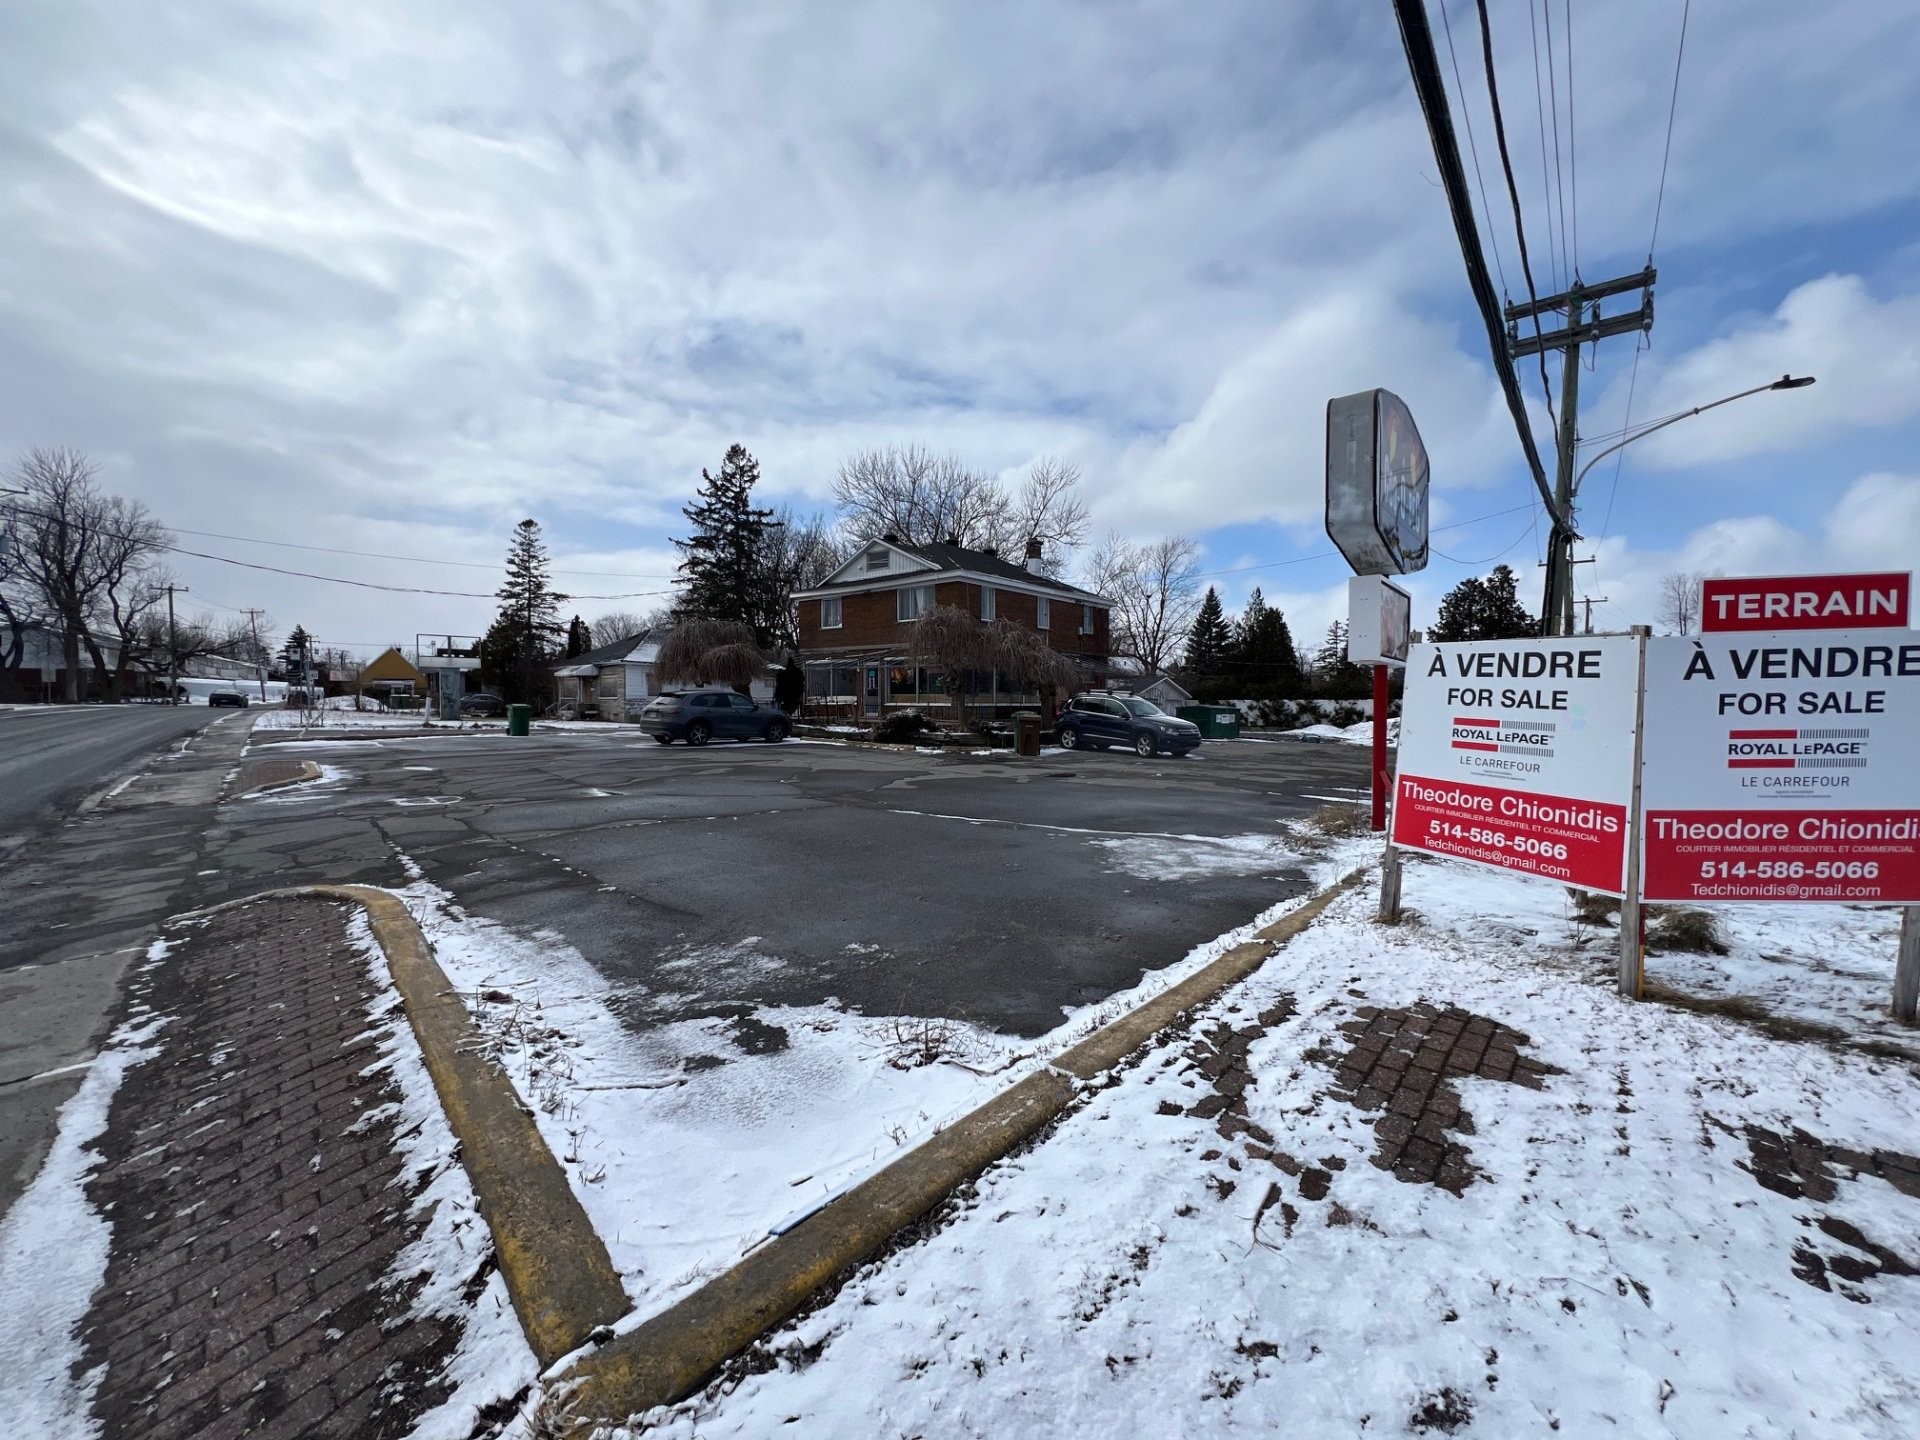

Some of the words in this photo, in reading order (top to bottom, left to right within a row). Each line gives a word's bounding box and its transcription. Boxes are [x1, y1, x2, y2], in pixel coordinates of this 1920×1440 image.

[1711, 589, 1898, 620] TERRAIN
[1427, 646, 1447, 677] À
[1456, 650, 1602, 679] VENDRE
[1683, 641, 1715, 681] À
[1729, 645, 1920, 680] VENDRE
[1447, 688, 1493, 707] FOR
[1500, 689, 1568, 710] SALE
[1718, 692, 1787, 715] FOR
[1797, 691, 1886, 714] SALE
[1452, 728, 1494, 741] ROYAL
[1728, 743, 1788, 755] ROYAL
[1460, 755, 1472, 765] LE
[1474, 757, 1541, 773] CARREFOUR
[1741, 776, 1758, 787] LE
[1763, 776, 1850, 787] CARREFOUR
[1402, 780, 1493, 811] Theodore
[1500, 796, 1619, 833] Chionidis
[1414, 803, 1445, 815] COURTIER
[1446, 809, 1484, 822] IMMOBILIER
[1485, 815, 1530, 830] RÉSIDENTIEL
[1532, 824, 1541, 832] ET
[1543, 826, 1600, 843] COMMERCIAL
[1652, 818, 1789, 840] Theodore
[1798, 817, 1920, 840] Chionidi
[1429, 819, 1568, 860] 514-586-5066
[1675, 845, 1721, 853] COURTIER
[1723, 845, 1777, 853] IMMOBILIER
[1779, 844, 1836, 853] RÉSIDENTIEL
[1838, 845, 1849, 853] ET
[1852, 845, 1915, 853] COMMERCIAL
[1423, 835, 1570, 878] Tedchionidis@gmail.com
[1700, 861, 1879, 879] 514-586-5066
[1690, 883, 1881, 899] Tedchionidis@gmail.com
